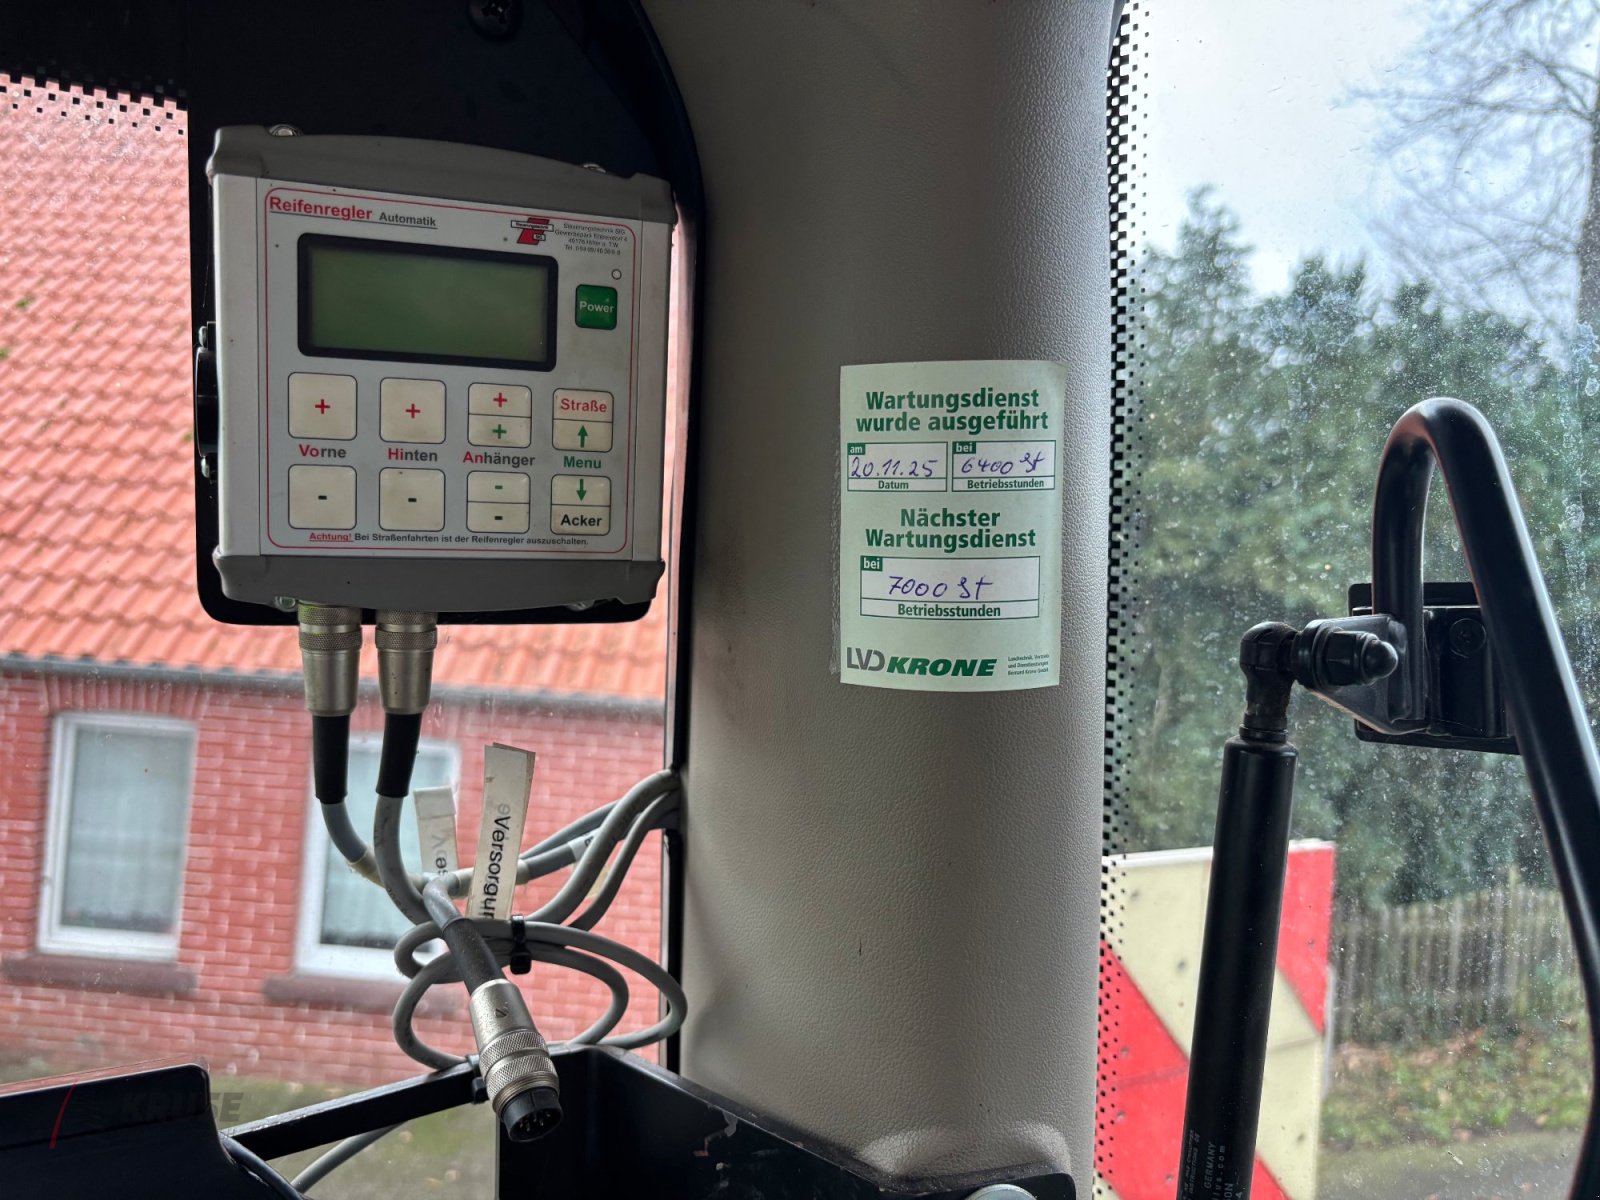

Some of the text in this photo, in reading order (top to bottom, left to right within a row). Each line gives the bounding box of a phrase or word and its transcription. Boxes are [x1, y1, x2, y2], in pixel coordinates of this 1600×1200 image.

[269, 196, 436, 226] Reifenregler Automatik
[579, 301, 615, 313] Power
[560, 398, 607, 413] Straße
[865, 387, 1039, 413] Wartungsdienst
[856, 410, 1049, 435] wurde ausgeführt
[298, 444, 347, 458] Vorne
[388, 448, 438, 462] Hinten
[849, 445, 863, 454] am
[955, 443, 973, 453] bei
[462, 451, 536, 468] Anhänger
[563, 455, 602, 469] Menu
[961, 457, 1014, 475] 6400
[851, 456, 938, 478] 20.11.25
[878, 480, 909, 490] Datum
[967, 479, 1045, 490] Betriebsstunden
[560, 514, 602, 527] Acker
[900, 508, 1000, 527] Nächster
[309, 532, 589, 546] Achtung! Bei Straßenfahrten ist der Reifenregler auszuschalten.
[865, 528, 1036, 553] Wartungsdienst
[863, 556, 880, 569] bei
[888, 575, 948, 598] 7000
[897, 603, 1001, 617] Betriebsstunden
[1203, 1140, 1217, 1189] GERMANY
